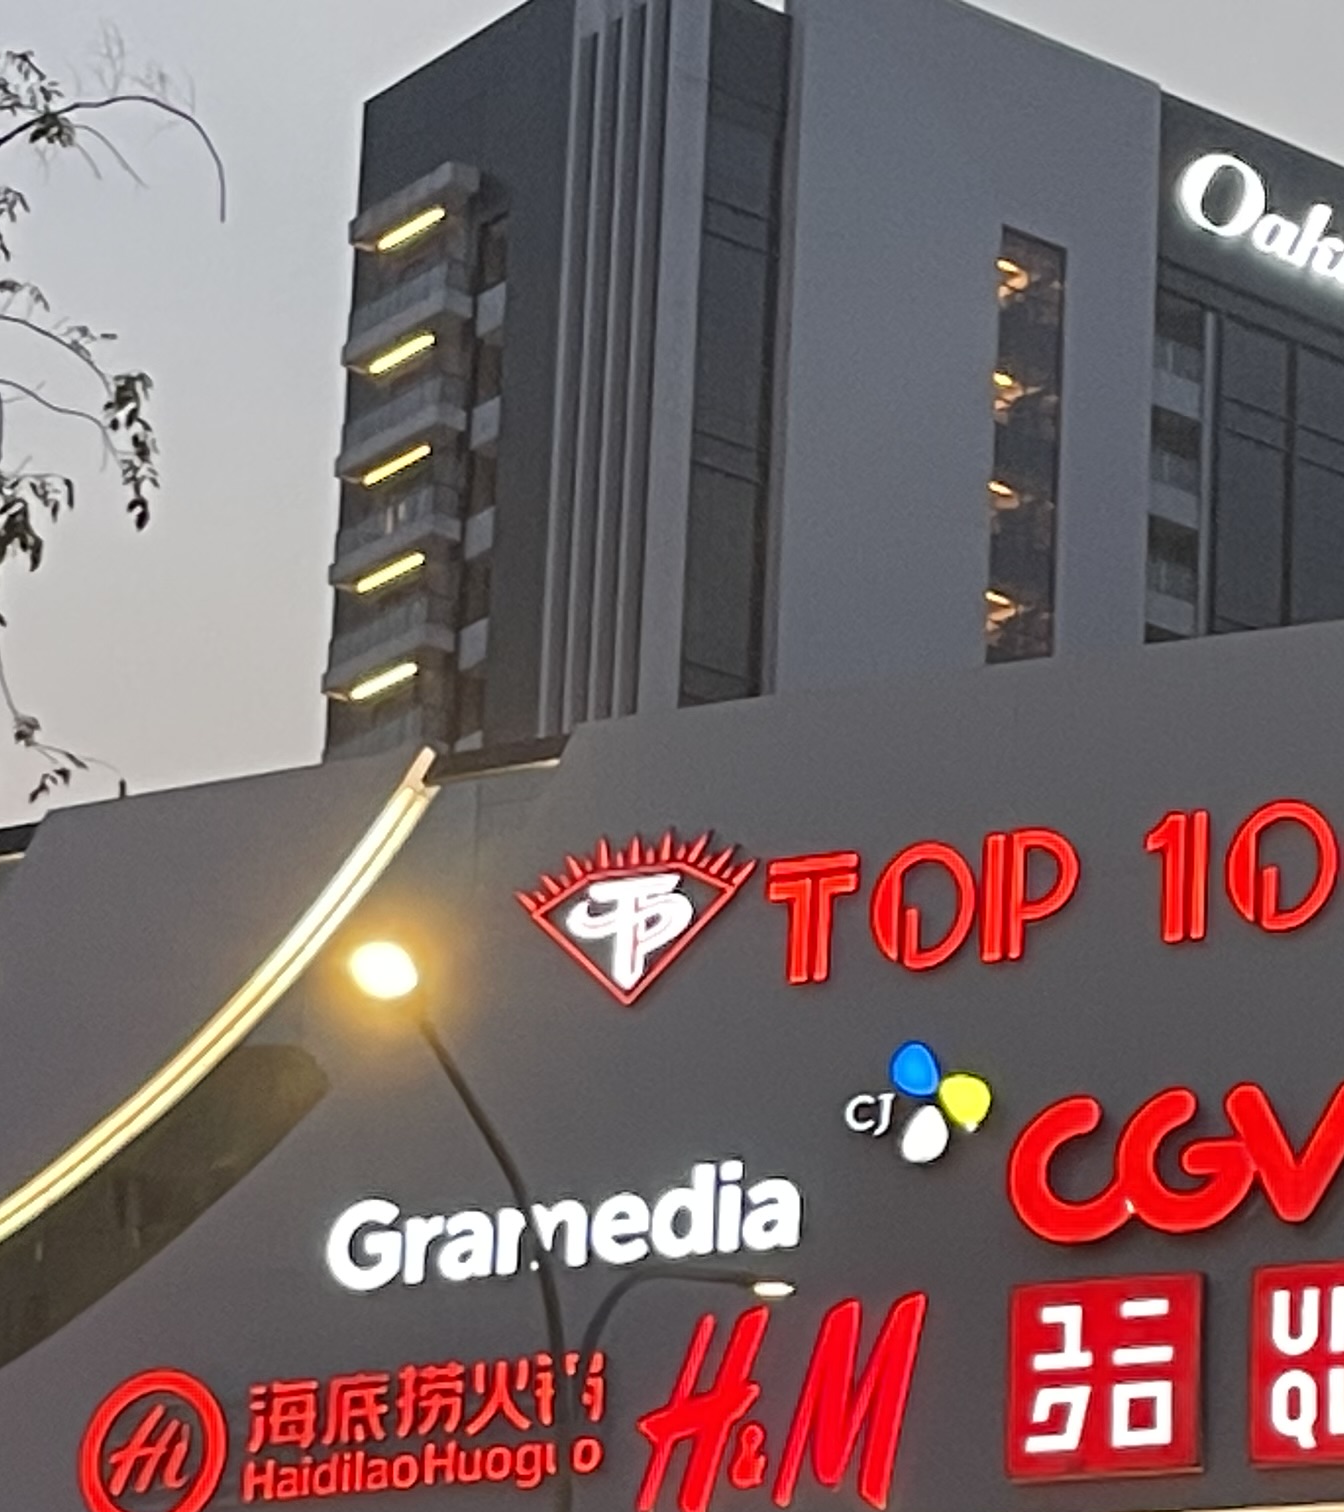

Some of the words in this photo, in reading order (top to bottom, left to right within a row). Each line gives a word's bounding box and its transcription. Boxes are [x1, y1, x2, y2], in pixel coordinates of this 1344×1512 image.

[766, 828, 1081, 985] TOP
[844, 1092, 895, 1136] CJ
[326, 1159, 801, 1292] Gramedia
